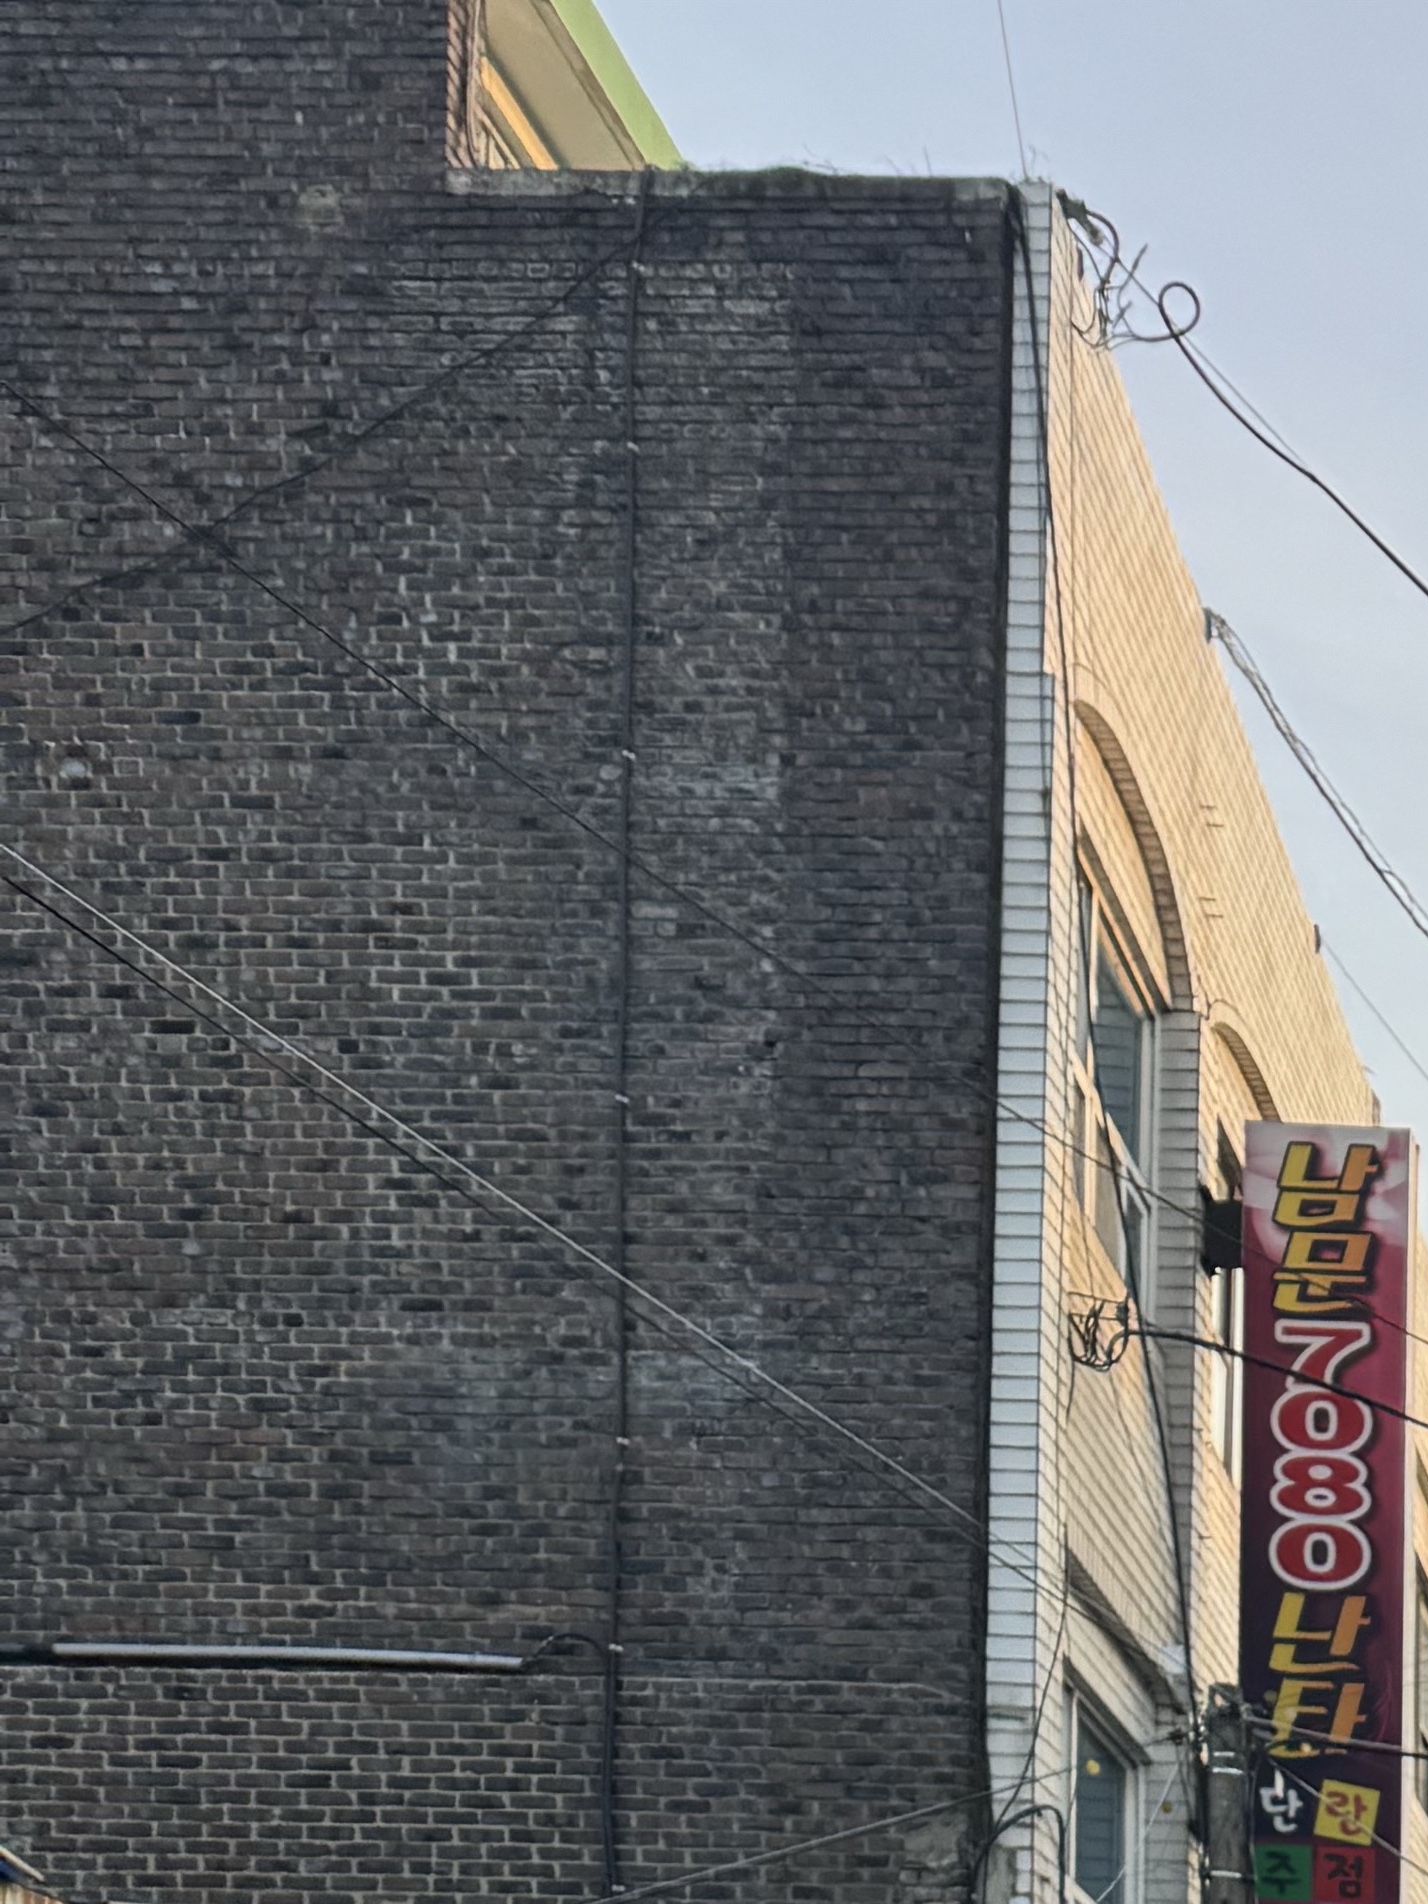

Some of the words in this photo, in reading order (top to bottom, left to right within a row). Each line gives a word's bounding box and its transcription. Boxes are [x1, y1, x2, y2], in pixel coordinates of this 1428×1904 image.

[1272, 1139, 1379, 1315] 남문
[1268, 1317, 1374, 1591] 7080
[1268, 1591, 1371, 1759] 난타
[1261, 1851, 1364, 1898] 주점
